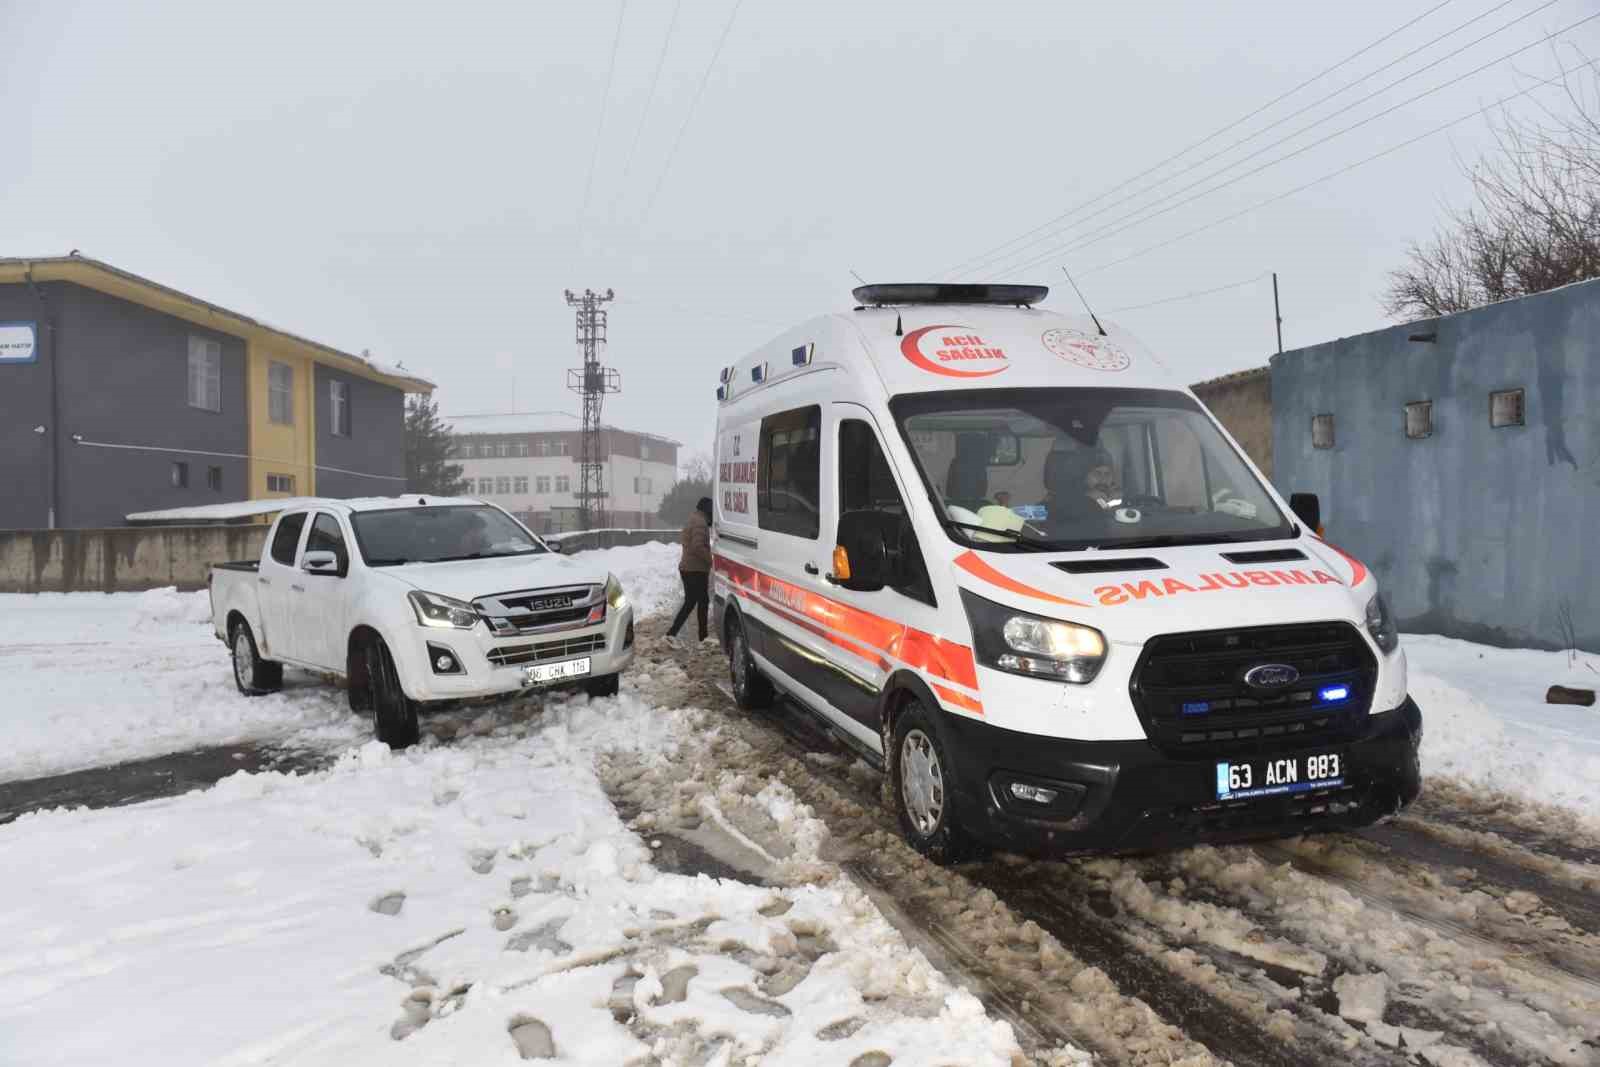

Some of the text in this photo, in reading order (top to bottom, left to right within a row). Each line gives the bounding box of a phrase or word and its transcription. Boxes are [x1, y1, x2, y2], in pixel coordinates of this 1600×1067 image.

[942, 334, 985, 346] ACİL
[936, 345, 1008, 361] SAĞLIK
[530, 596, 574, 610] ISUZU
[1259, 667, 1290, 684] Ford
[1229, 754, 1339, 789] 63 ACN 883
